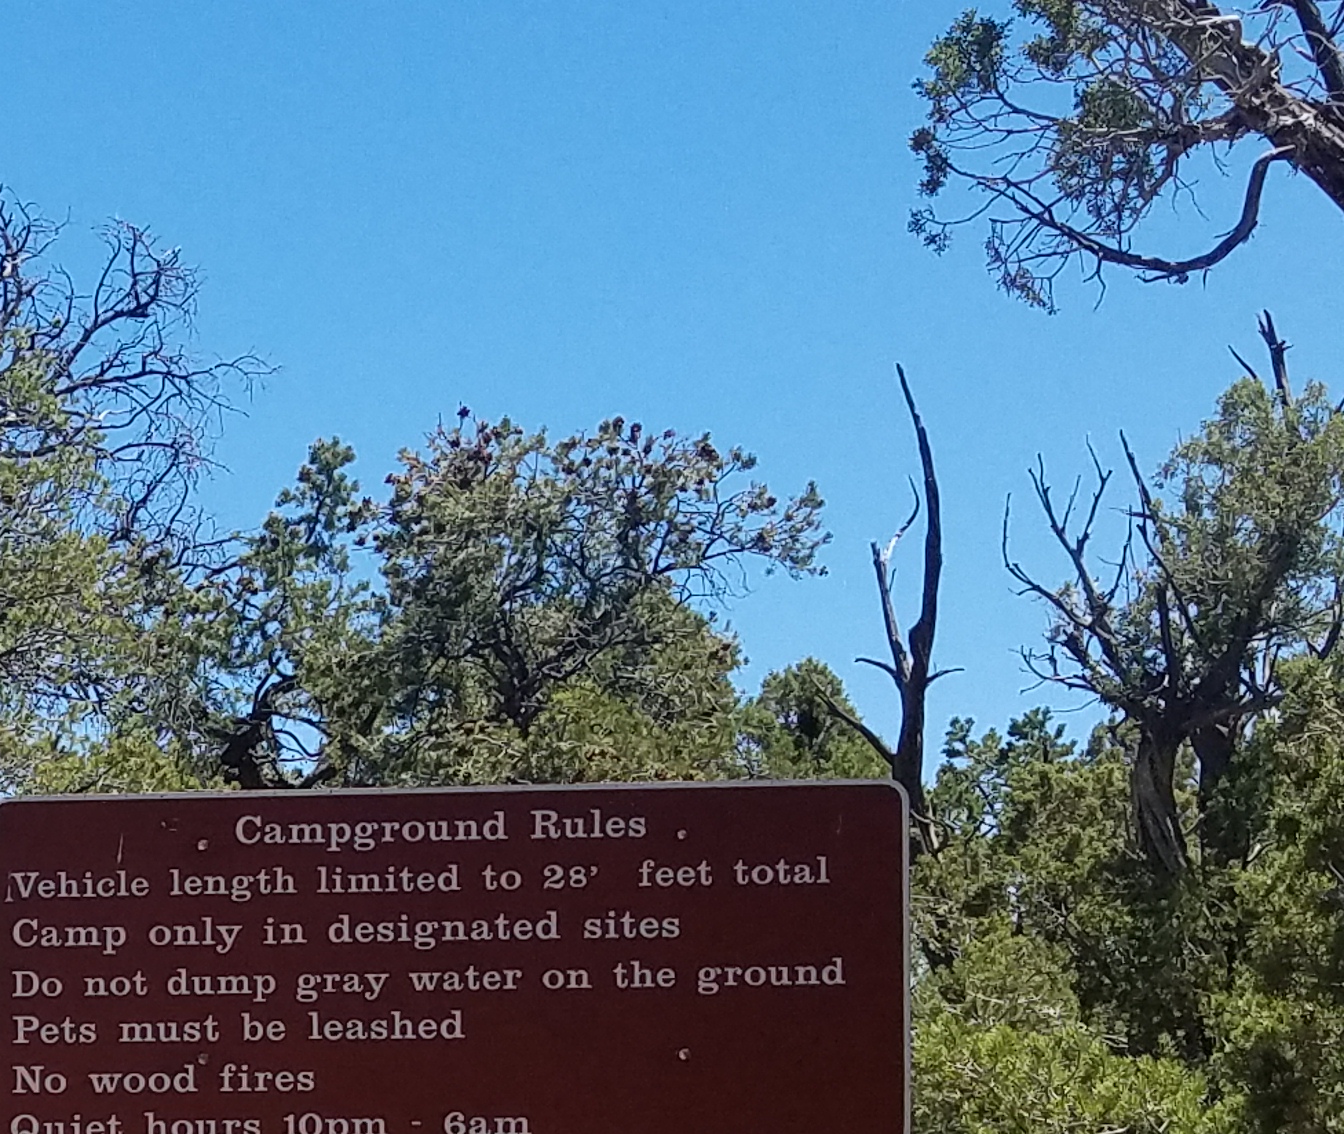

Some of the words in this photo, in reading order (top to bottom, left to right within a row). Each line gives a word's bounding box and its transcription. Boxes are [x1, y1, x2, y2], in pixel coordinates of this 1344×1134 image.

[236, 811, 508, 851] Campground
[531, 810, 646, 839] Rules
[9, 871, 148, 900] Vehicle
[170, 868, 297, 901] length
[317, 865, 460, 892] limited
[482, 865, 521, 889] to
[639, 860, 712, 886] feet
[734, 857, 829, 884] total
[13, 919, 125, 954] Camp
[149, 917, 242, 953] only
[264, 918, 307, 944] in
[329, 911, 560, 949] designated
[584, 911, 679, 938] sites
[12, 971, 62, 996] Do
[84, 971, 147, 995] not
[168, 969, 275, 1001] dump
[297, 974, 389, 1002] gray
[409, 966, 521, 990] water
[543, 970, 591, 988] on
[613, 961, 675, 987] the
[698, 958, 845, 994] ground
[13, 1016, 96, 1043] Pets
[119, 1015, 219, 1041] must
[241, 1013, 285, 1040] be
[308, 1010, 465, 1040] leashed
[13, 1066, 66, 1093] No
[88, 1065, 197, 1092] wood
[220, 1064, 314, 1091] fires
